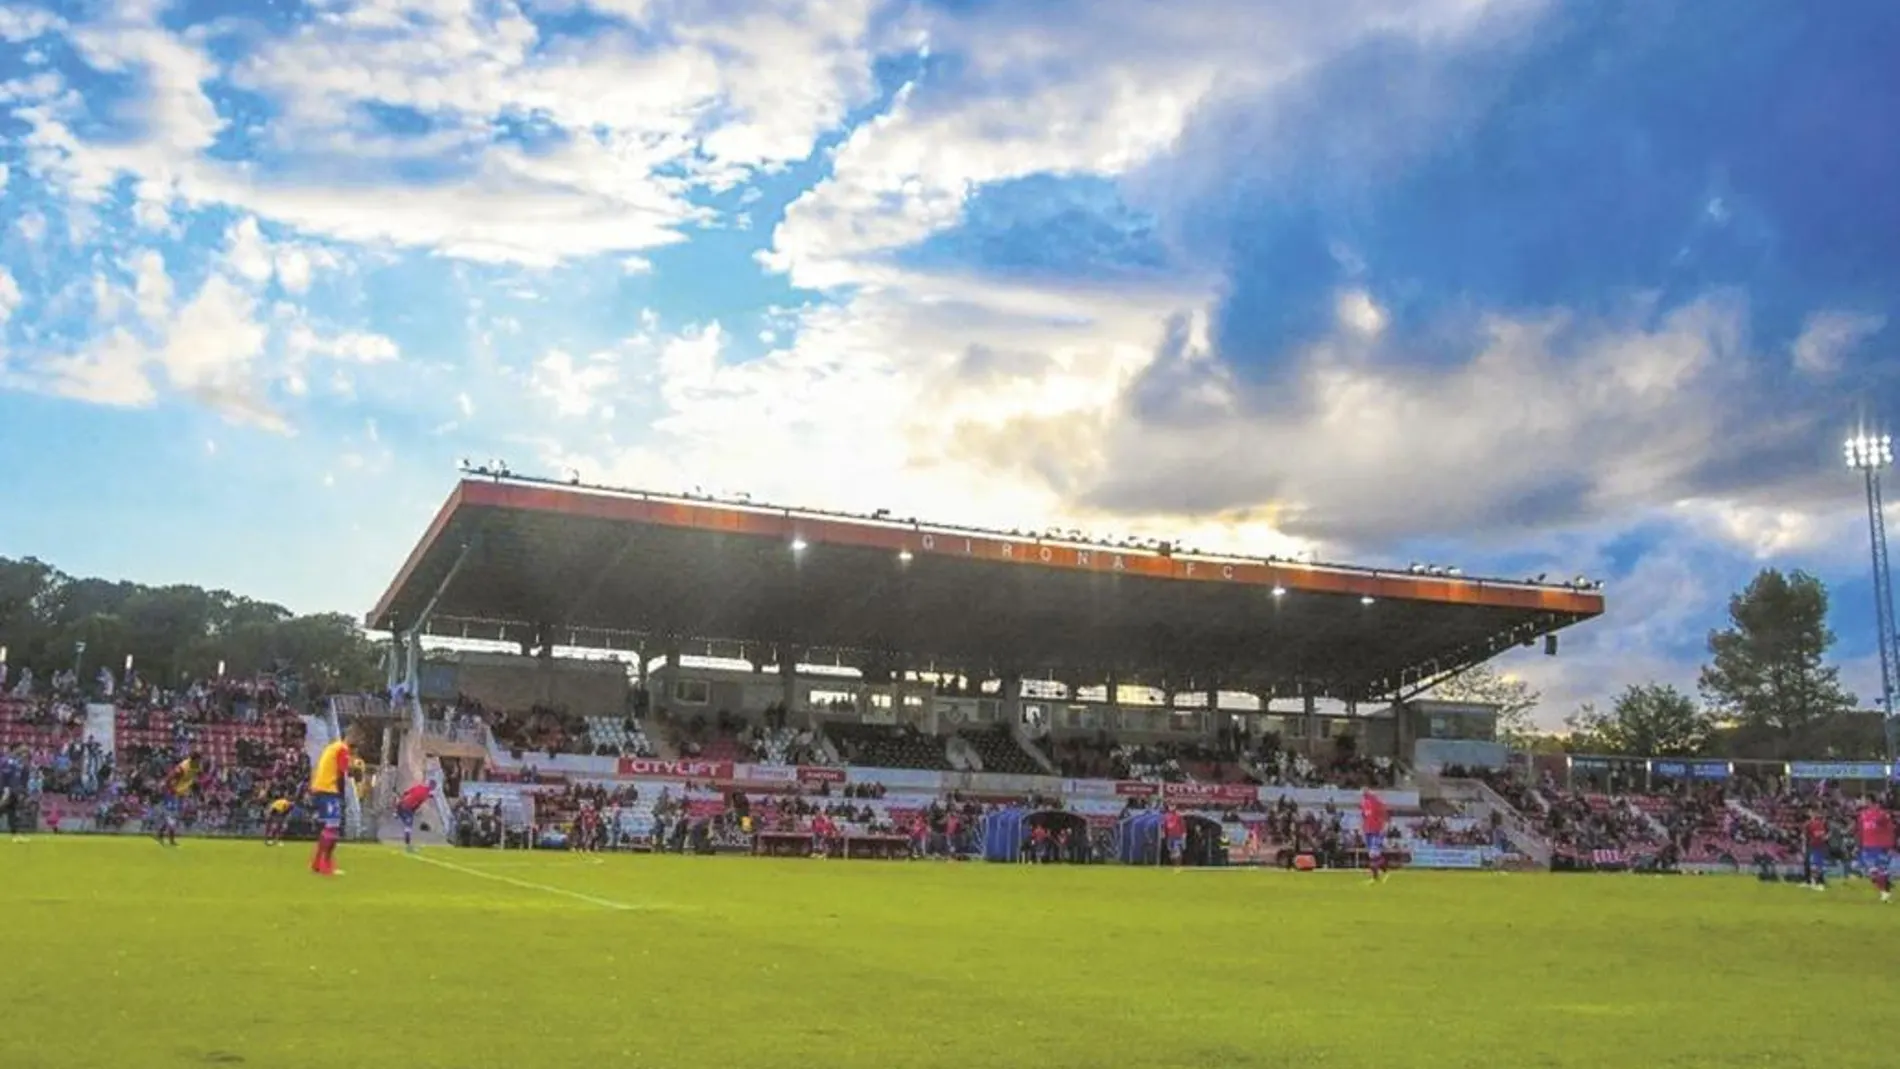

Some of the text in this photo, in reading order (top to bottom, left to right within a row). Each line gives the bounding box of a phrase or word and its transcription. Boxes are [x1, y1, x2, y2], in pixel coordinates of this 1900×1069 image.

[922, 533, 1234, 579] GIRONA FC
[631, 759, 722, 777] CITYLIFT
